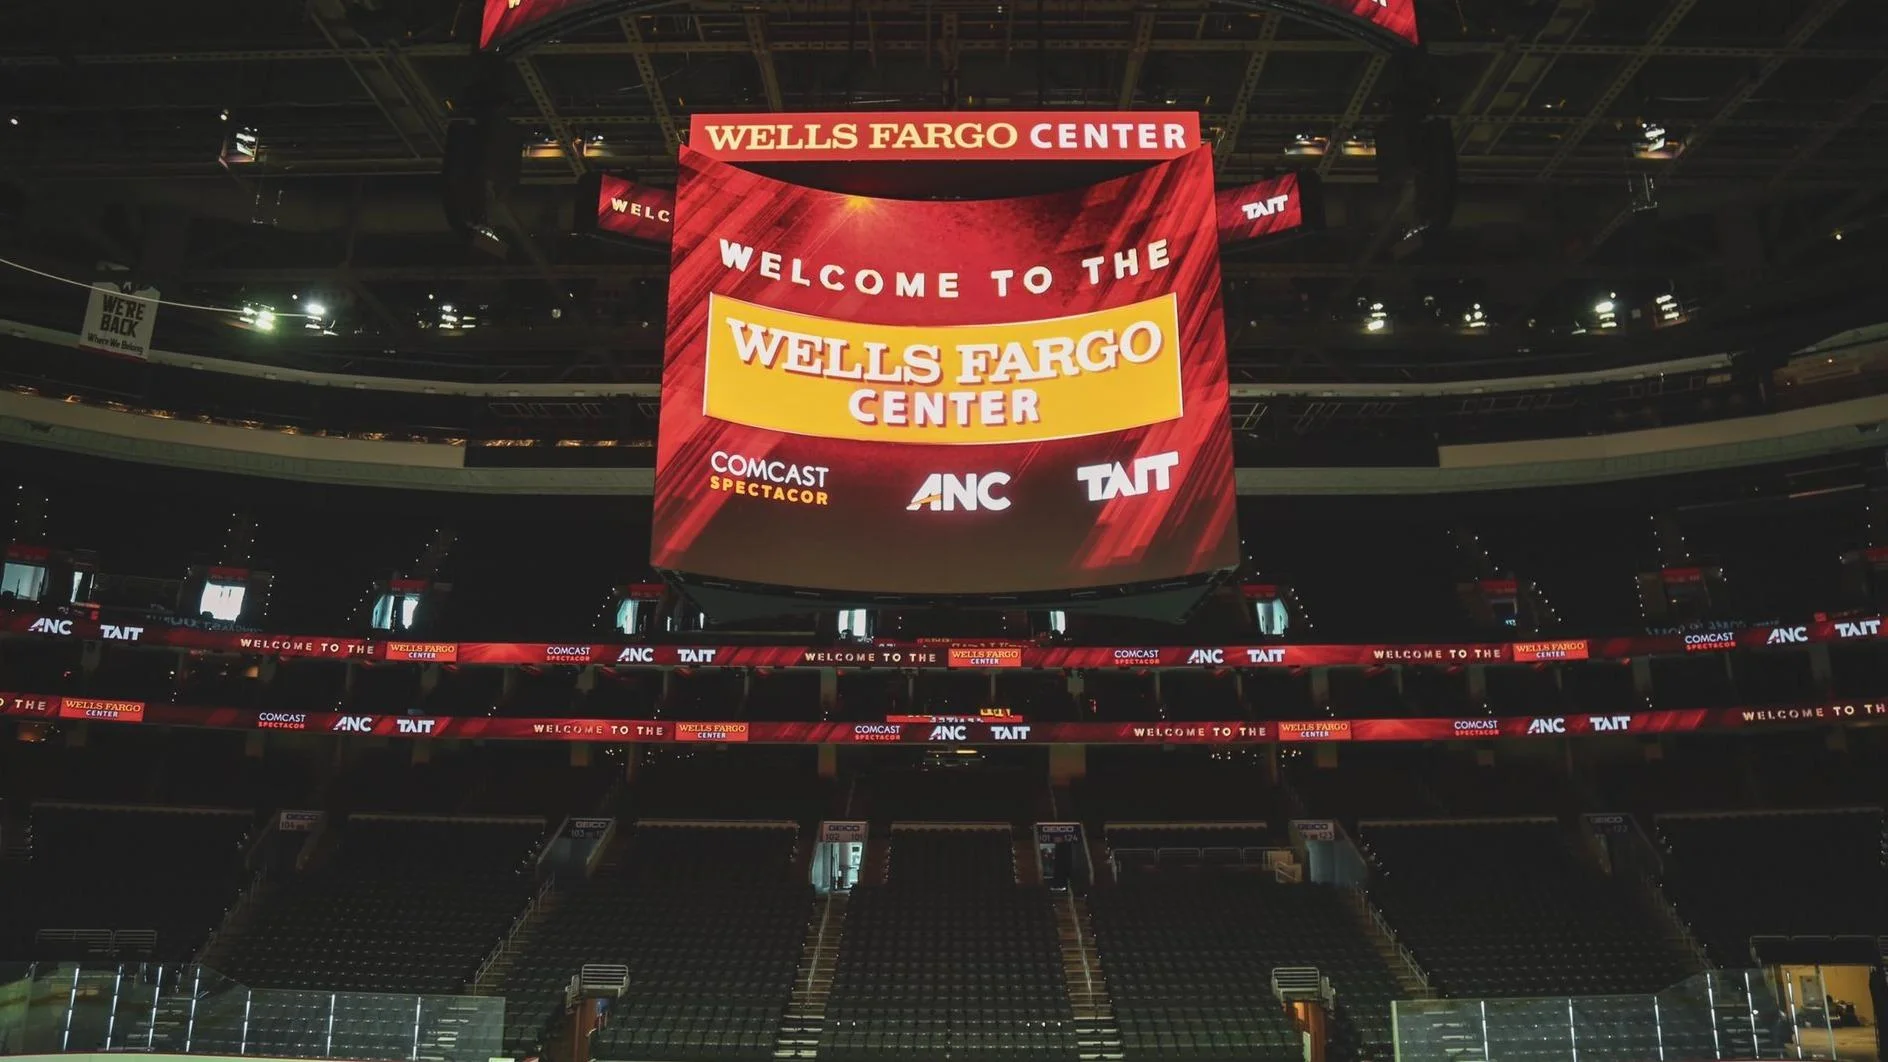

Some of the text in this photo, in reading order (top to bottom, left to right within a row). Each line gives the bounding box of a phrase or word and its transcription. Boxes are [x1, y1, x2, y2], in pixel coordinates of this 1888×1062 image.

[705, 123, 1187, 150] WELLS FARGO CENTER
[611, 197, 670, 222] WELC
[1242, 194, 1289, 218] TAIT
[719, 238, 1170, 298] WELCOME TO THE
[100, 313, 139, 338] BACK
[726, 316, 1163, 386] WELLS FARGO
[848, 388, 1040, 428] CENTER
[711, 451, 829, 487] COMCAST
[1077, 451, 1179, 501] TAIT
[710, 475, 829, 505] SPECTACOR
[906, 472, 1011, 511] ANC
[28, 617, 73, 636] ANC
[100, 624, 144, 641] TAIT
[1834, 620, 1882, 638] TAIT
[1685, 632, 1734, 644] COMCAST
[1766, 627, 1808, 644] ANC
[240, 637, 374, 655] WELCOME TO THE
[390, 644, 455, 653] WELLS FARGO
[547, 646, 590, 656] COMCAST
[1515, 642, 1584, 653] WELLS FARGO
[408, 651, 436, 659] CENTER
[617, 648, 654, 662] ANC
[677, 649, 716, 663] TAIT
[805, 652, 936, 662] WELCOME TO THE
[951, 650, 1018, 658] WELLS FARGO
[1114, 650, 1159, 659] COMCAST
[1187, 649, 1224, 664] ANC
[1247, 649, 1285, 663] TAIT
[1373, 649, 1501, 659] WELCOME TO THE
[1536, 651, 1566, 659] CENTER
[15, 699, 46, 711] THE
[65, 700, 141, 712] WELLS FARGO
[85, 709, 118, 718] CENTER
[259, 712, 306, 723] COMCAST
[1742, 703, 1886, 722] WELCOME TO TH
[333, 716, 372, 733] ANC
[396, 719, 435, 733] TAIT
[533, 725, 663, 736] WELCOME TO THE
[679, 724, 746, 733] WELLS FARGO
[855, 725, 900, 734] COMCAST
[1281, 722, 1348, 732] WELLS FARGO
[1454, 720, 1498, 730] COMCAST
[1527, 718, 1566, 734] ANC
[1589, 716, 1631, 731] TAIT
[928, 726, 967, 741] ANC
[990, 726, 1031, 740] TAIT
[1134, 727, 1267, 737] WELCOME TO THE
